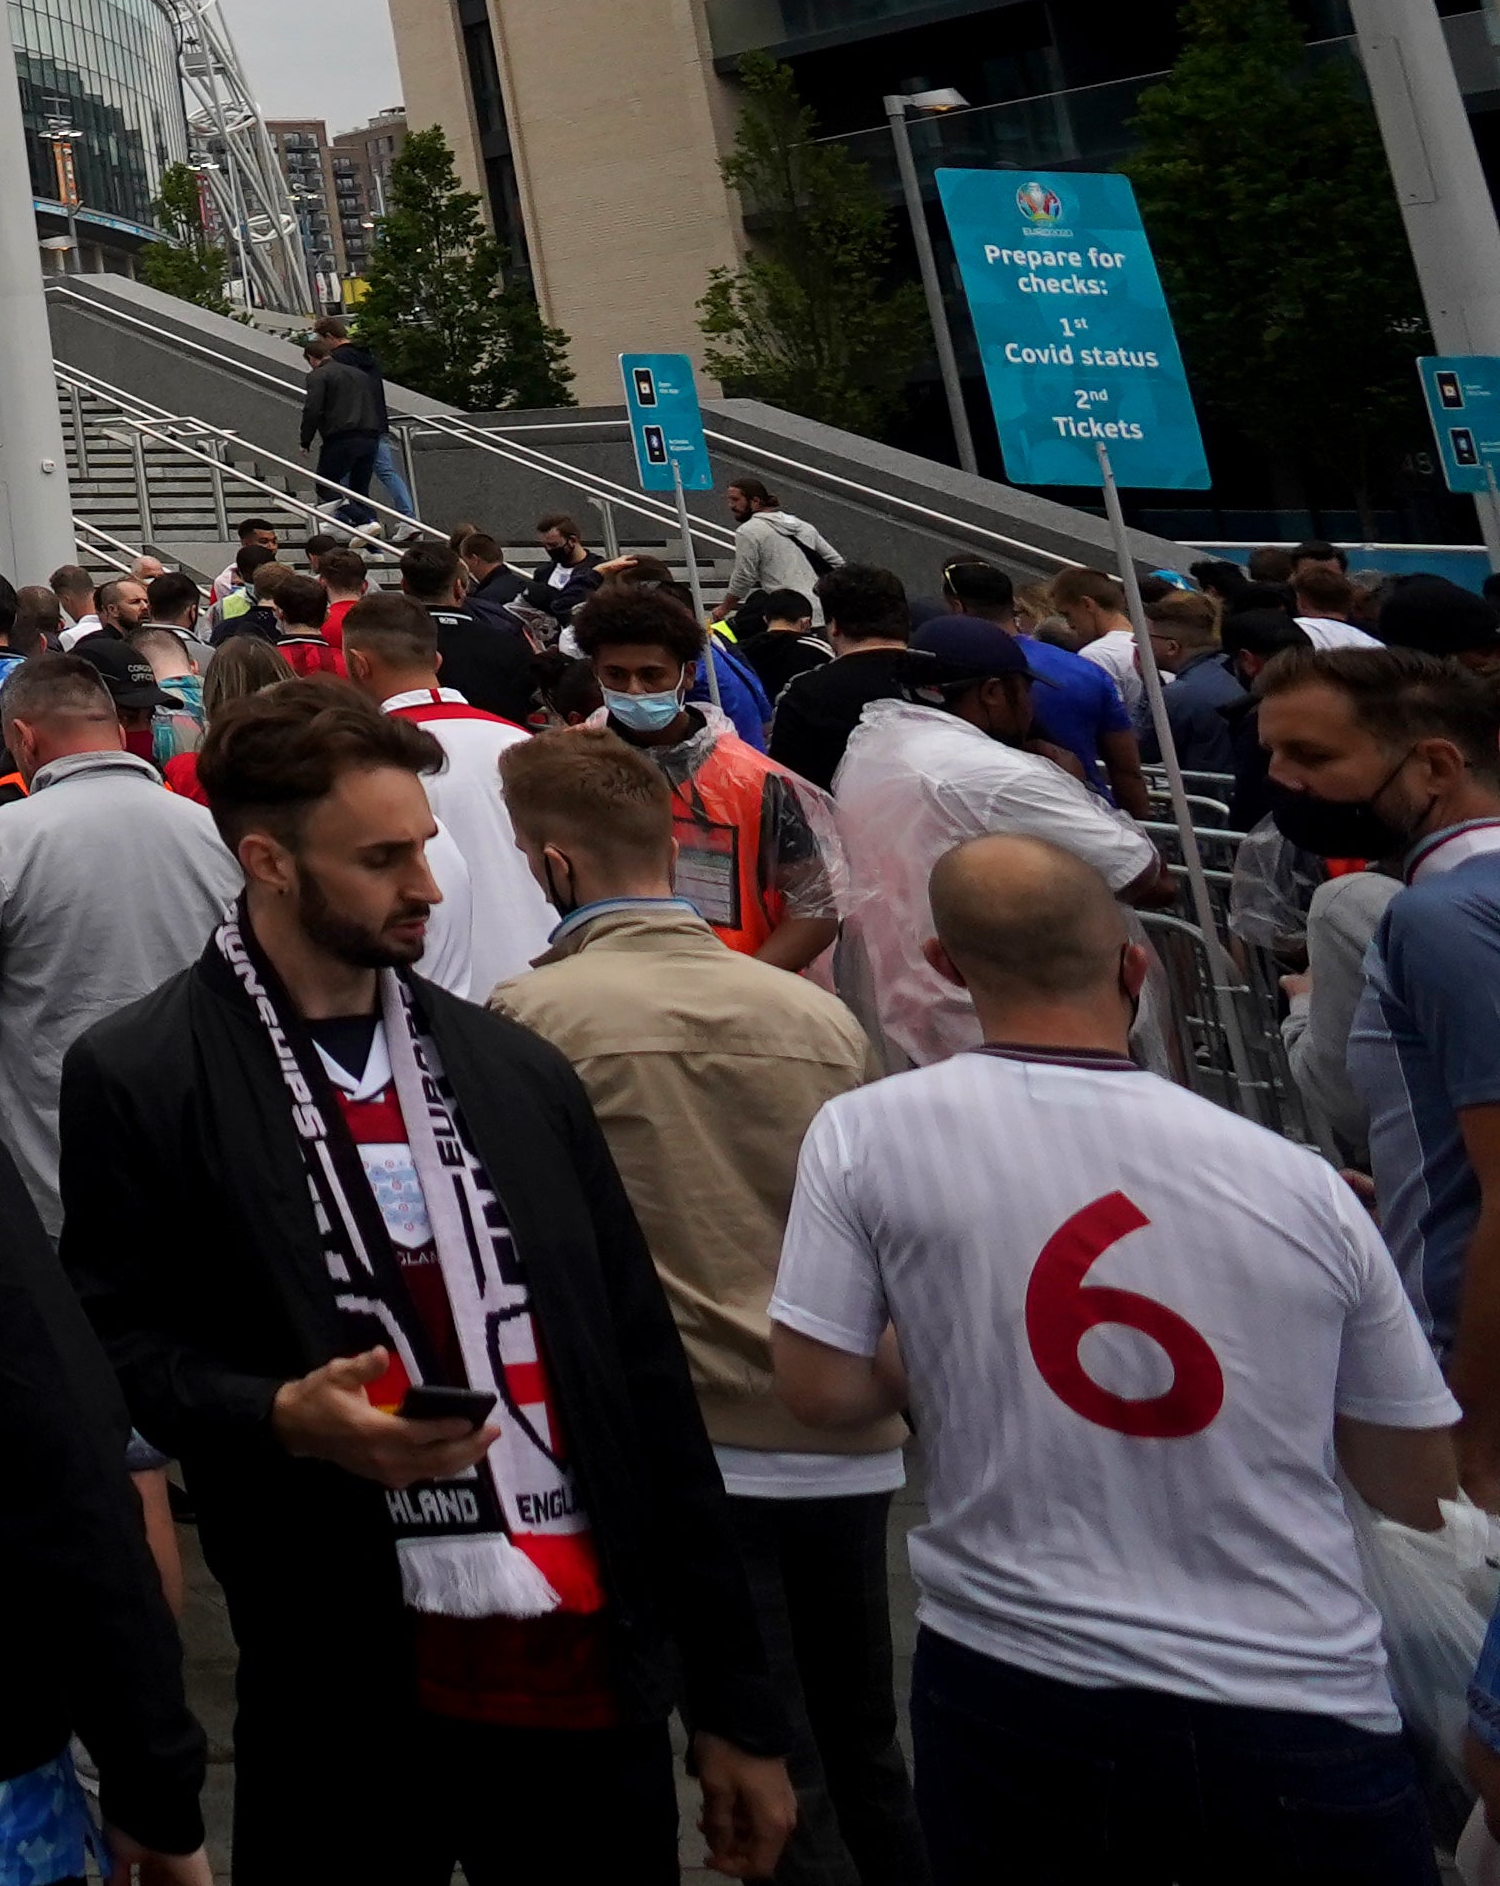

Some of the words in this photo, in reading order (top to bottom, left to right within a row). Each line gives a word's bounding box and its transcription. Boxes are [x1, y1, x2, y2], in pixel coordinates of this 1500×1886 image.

[984, 245, 1082, 270] Prepare
[1087, 248, 1126, 268] for
[1018, 273, 1108, 295] checks:
[1005, 343, 1074, 365] Covid
[1080, 348, 1159, 368] status
[1053, 416, 1143, 440] Tickets
[1024, 1189, 1225, 1440] 6
